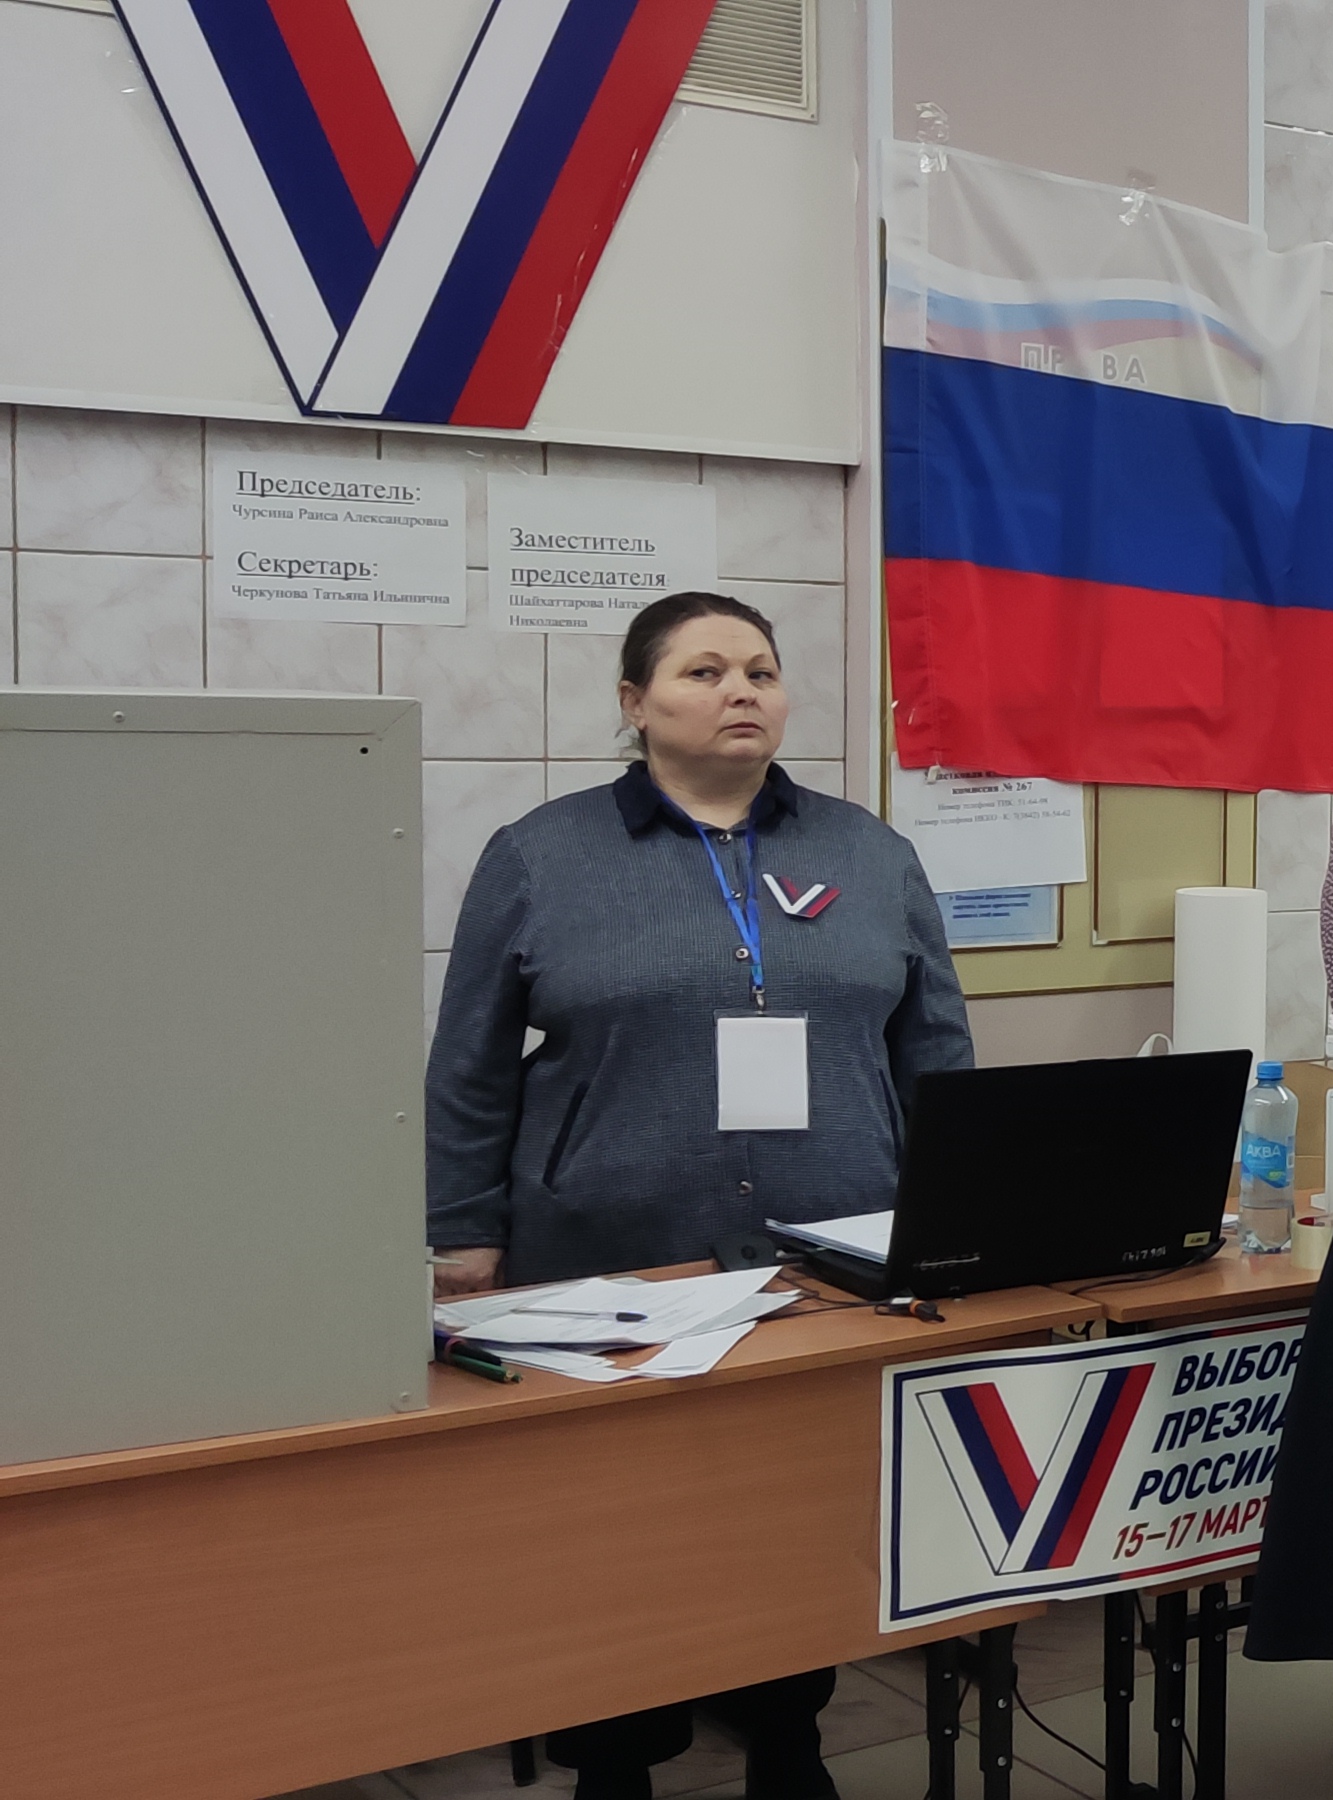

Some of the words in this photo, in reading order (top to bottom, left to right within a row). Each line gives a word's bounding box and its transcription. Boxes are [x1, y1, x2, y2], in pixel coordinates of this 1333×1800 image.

[1024, 345, 1145, 384] ПРВА
[236, 470, 422, 503] Председатель:
[232, 503, 294, 524] Чурсина
[298, 507, 338, 523] Раиса
[342, 510, 450, 529] Александровна
[510, 527, 656, 554] Заместитель
[237, 551, 378, 581] Секретарь:
[231, 584, 309, 605] Черкунова
[313, 586, 369, 603] Татьяна
[509, 614, 588, 632] Николаевна
[1016, 781, 1032, 791] 267
[1246, 1143, 1281, 1159] АКВА
[1172, 1338, 1304, 1397] ВЫБОР
[1196, 1495, 1270, 1544] МАРТ
